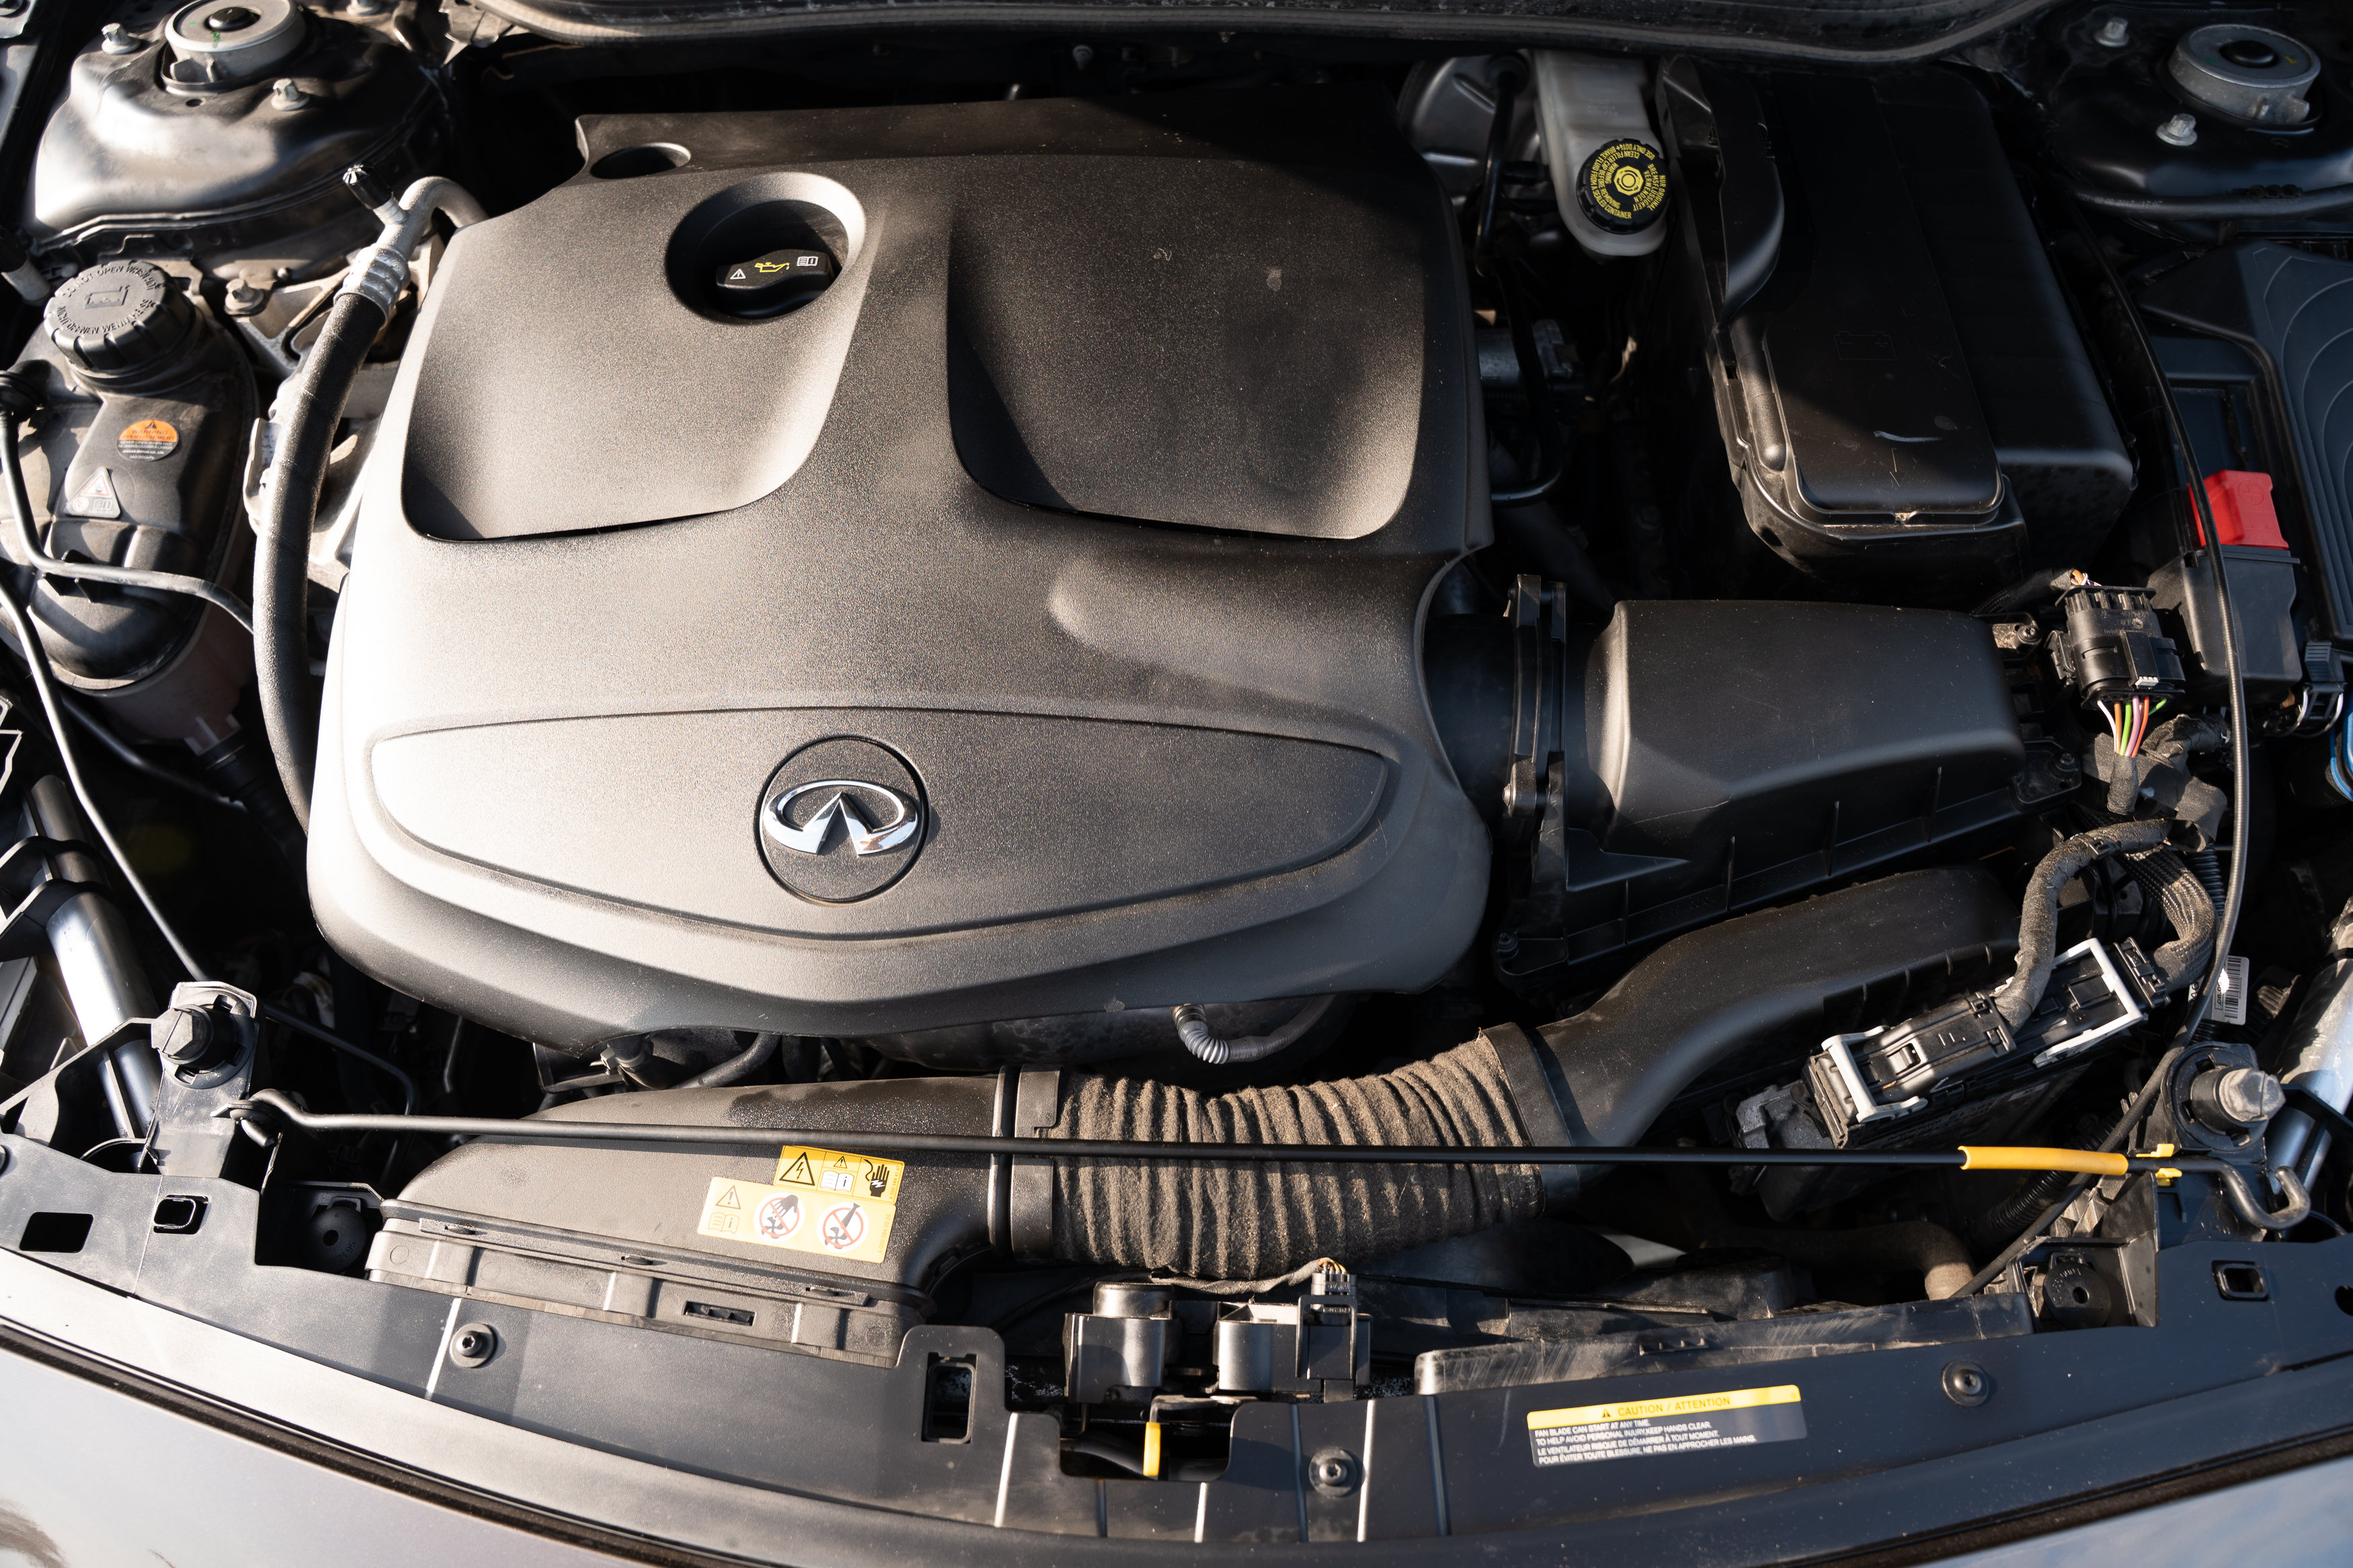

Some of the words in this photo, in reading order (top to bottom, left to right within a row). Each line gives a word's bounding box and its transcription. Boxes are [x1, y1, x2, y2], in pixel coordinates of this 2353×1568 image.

[1600, 146, 1617, 159] BRAKE
[1607, 151, 1624, 165] FILLER
[1624, 151, 1640, 159] CLEAN
[1644, 150, 1656, 161] USE
[1592, 156, 1604, 171] FLUID
[1601, 161, 1610, 171] CAP
[1590, 171, 1598, 185] FROM
[1597, 170, 1606, 189] BEFORE
[1604, 162, 1620, 184] WARNING
[1633, 170, 1652, 202] VERWENDEN
[1592, 190, 1607, 208] SEALED
[1600, 188, 1621, 209] REMOVING
[1646, 188, 1665, 211] ORIGINAL
[1604, 204, 1632, 219] CONTAINER
[97, 266, 124, 276] OPEN
[346, 1241, 356, 1253] 95
[1618, 1404, 1663, 1416] CAUTION
[1675, 1397, 1730, 1411] ATTENTION
[1534, 1429, 1549, 1438] FAN
[1549, 1427, 1572, 1436] BLADE
[1572, 1425, 1588, 1434] CAN
[1587, 1423, 1610, 1432] START
[1610, 1421, 1619, 1430] AT
[1619, 1420, 1633, 1429] ANY
[1634, 1419, 1651, 1427] TIME.
[1536, 1438, 1546, 1446] TO
[1546, 1436, 1565, 1445] HELP
[1565, 1434, 1587, 1443] AVOID
[1587, 1430, 1624, 1442] PERSONAL
[1663, 1423, 1688, 1432] HANDS
[1687, 1421, 1712, 1431] CLEAR.
[1537, 1448, 1546, 1456] LE
[1546, 1443, 1591, 1455] VENTILATEUR
[1591, 1440, 1618, 1450] RISQUE
[1628, 1436, 1665, 1446] DÉMARRER
[1665, 1434, 1672, 1442] À
[1671, 1432, 1689, 1442] TOUT
[1538, 1456, 1559, 1464] POUR
[1559, 1453, 1583, 1463] ÉVITER
[1583, 1451, 1607, 1460] TOUTE
[1653, 1444, 1668, 1452] PAS
[1667, 1442, 1678, 1451] EN
[1677, 1438, 1719, 1450] APPROCHER
[1719, 1436, 1733, 1445] LES
